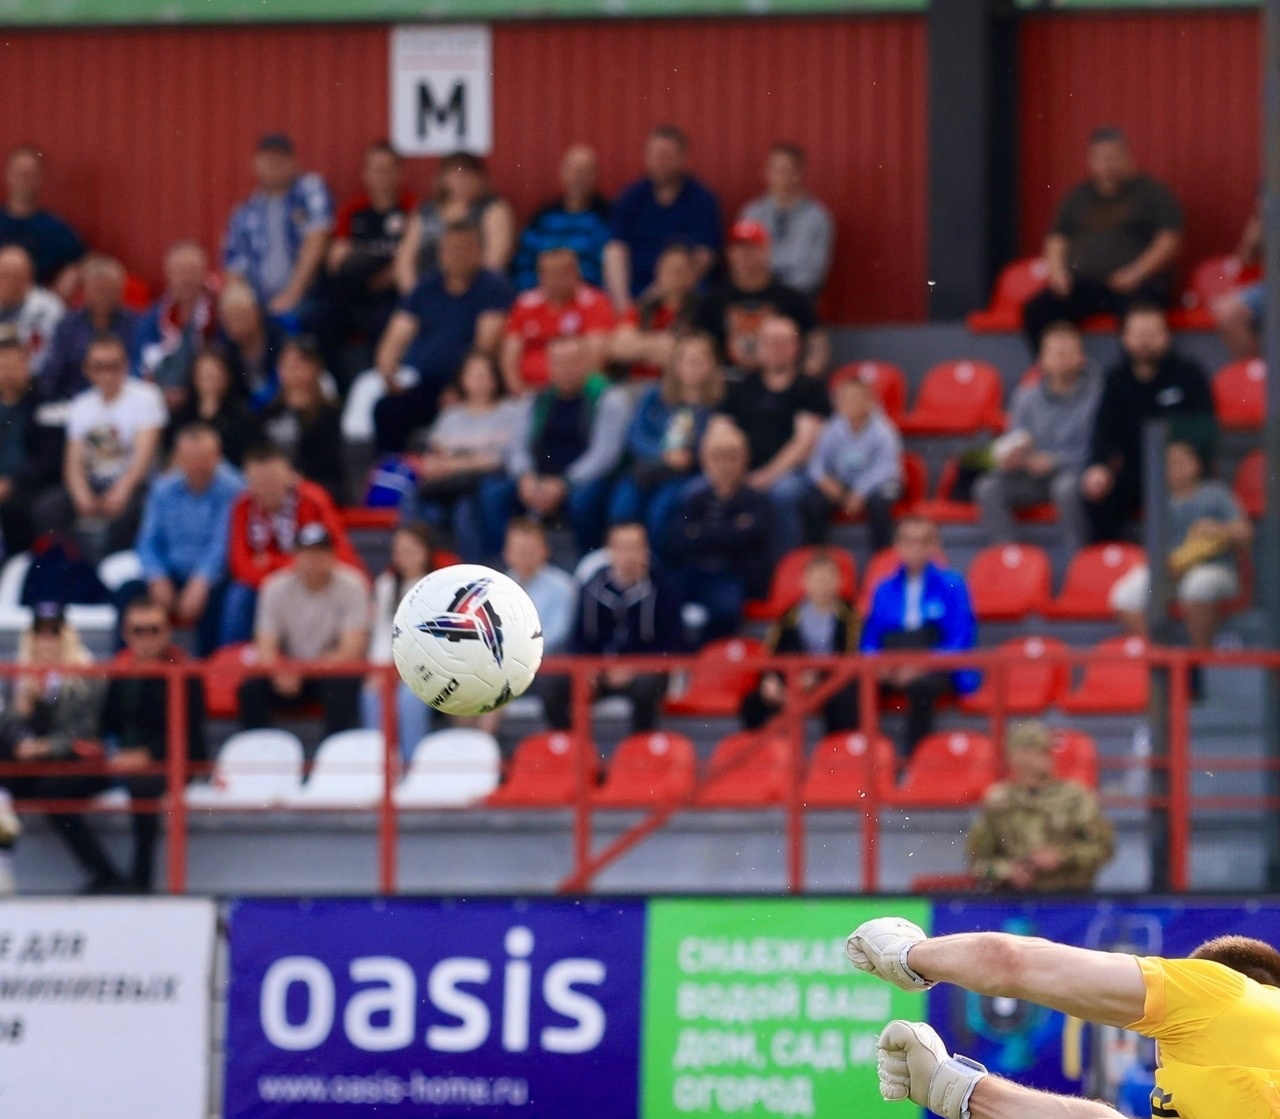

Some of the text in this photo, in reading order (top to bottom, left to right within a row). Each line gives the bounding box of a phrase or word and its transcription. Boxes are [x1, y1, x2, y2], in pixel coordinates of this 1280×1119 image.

[677, 936, 862, 975] СНАБЖАЕ
[259, 925, 606, 1053] oasis
[676, 976, 891, 1023] ВОДОЙ ВАШ
[771, 1028, 846, 1072] САД
[672, 1073, 815, 1119] ОГОРОД
